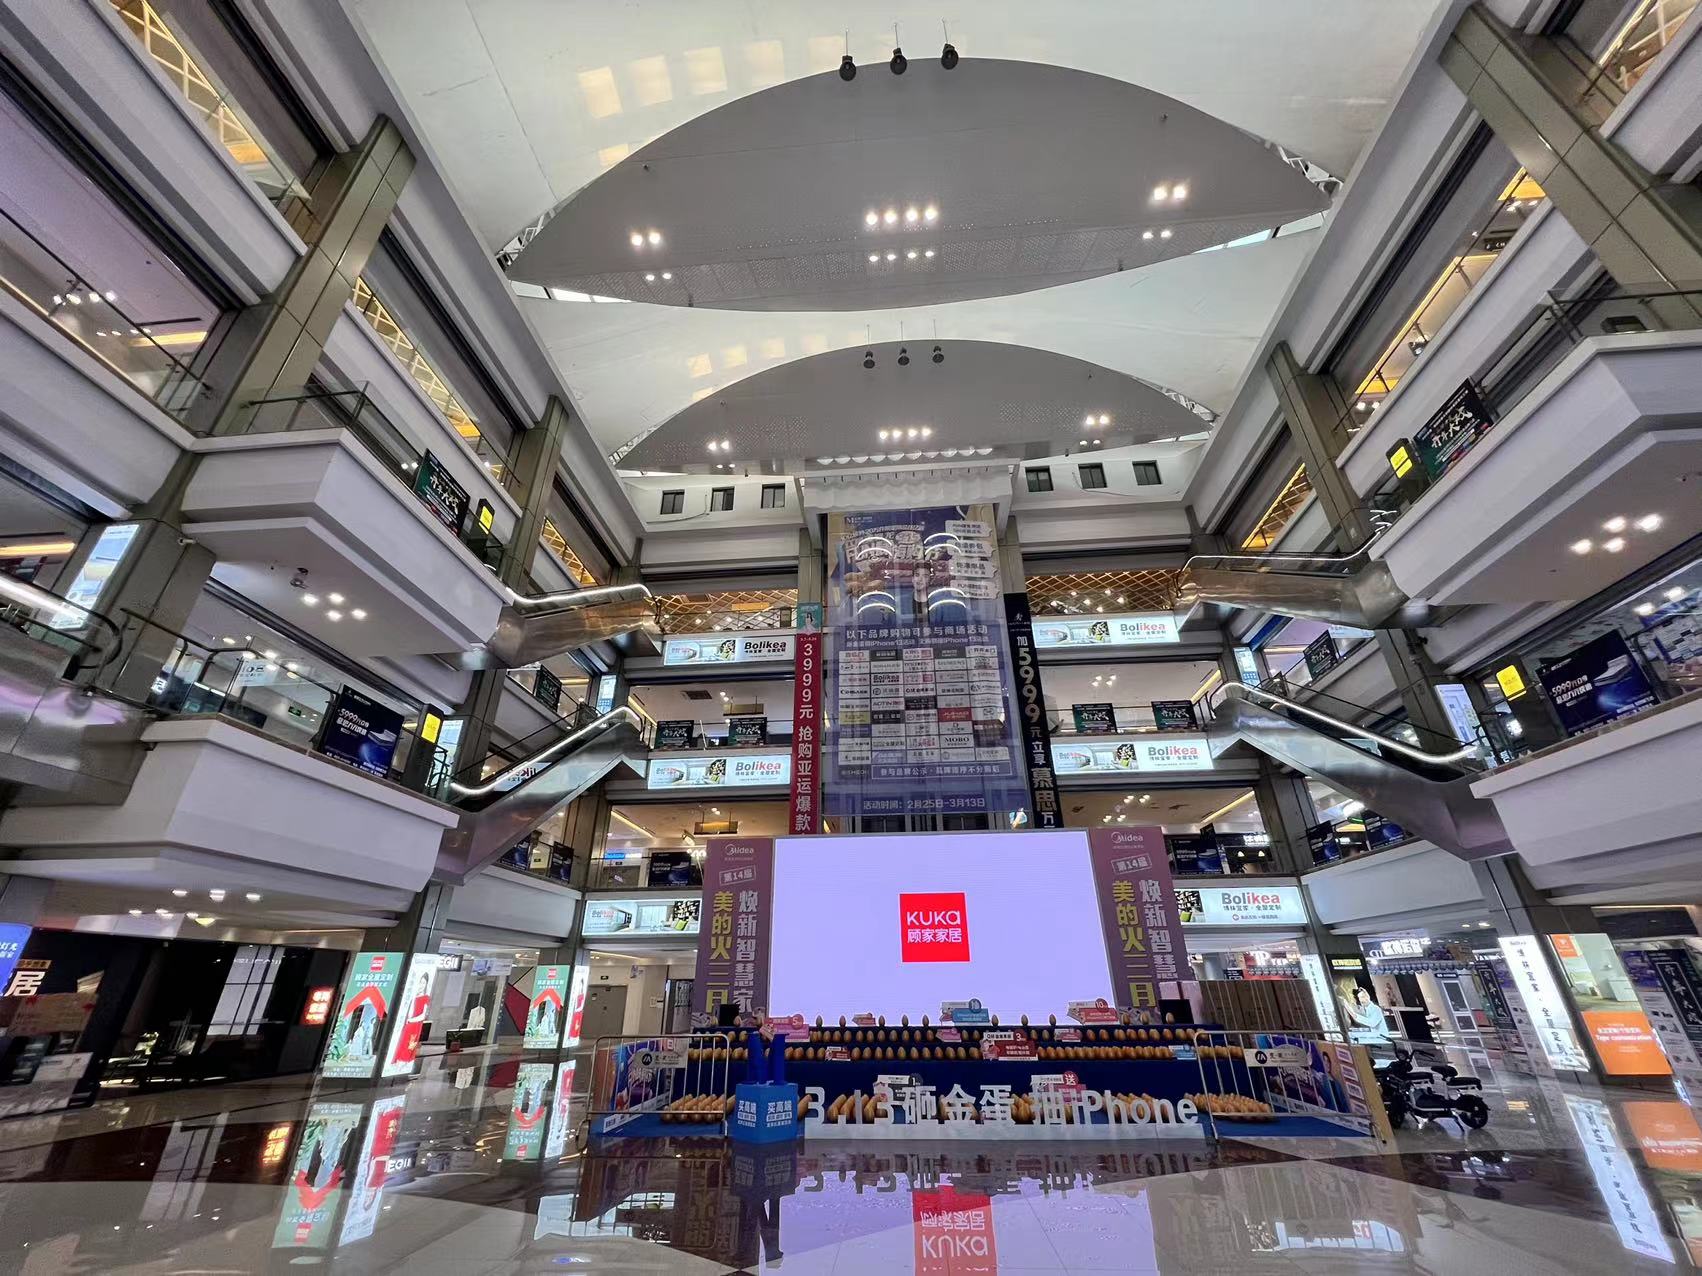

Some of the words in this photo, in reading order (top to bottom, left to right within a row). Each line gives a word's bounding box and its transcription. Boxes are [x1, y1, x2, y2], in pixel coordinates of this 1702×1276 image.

[846, 624, 988, 639] 以下品牌购物可参与商场活动
[1120, 623, 1166, 632] Bolikea
[744, 640, 787, 650] Bolikea
[802, 643, 814, 719] 3999元
[1148, 746, 1198, 756] Bolikea
[735, 761, 781, 771] Bolikea
[795, 725, 813, 832] 抢购亚运爆款
[1111, 831, 1144, 844] Midea
[725, 843, 754, 856] Midea
[1116, 856, 1149, 872] 第14届
[723, 870, 753, 883] 第14届
[1221, 892, 1281, 905] Bolikea
[907, 928, 962, 943] 顾家家居
[1112, 880, 1157, 1008] 美的火三月
[4, 970, 46, 997] 居
